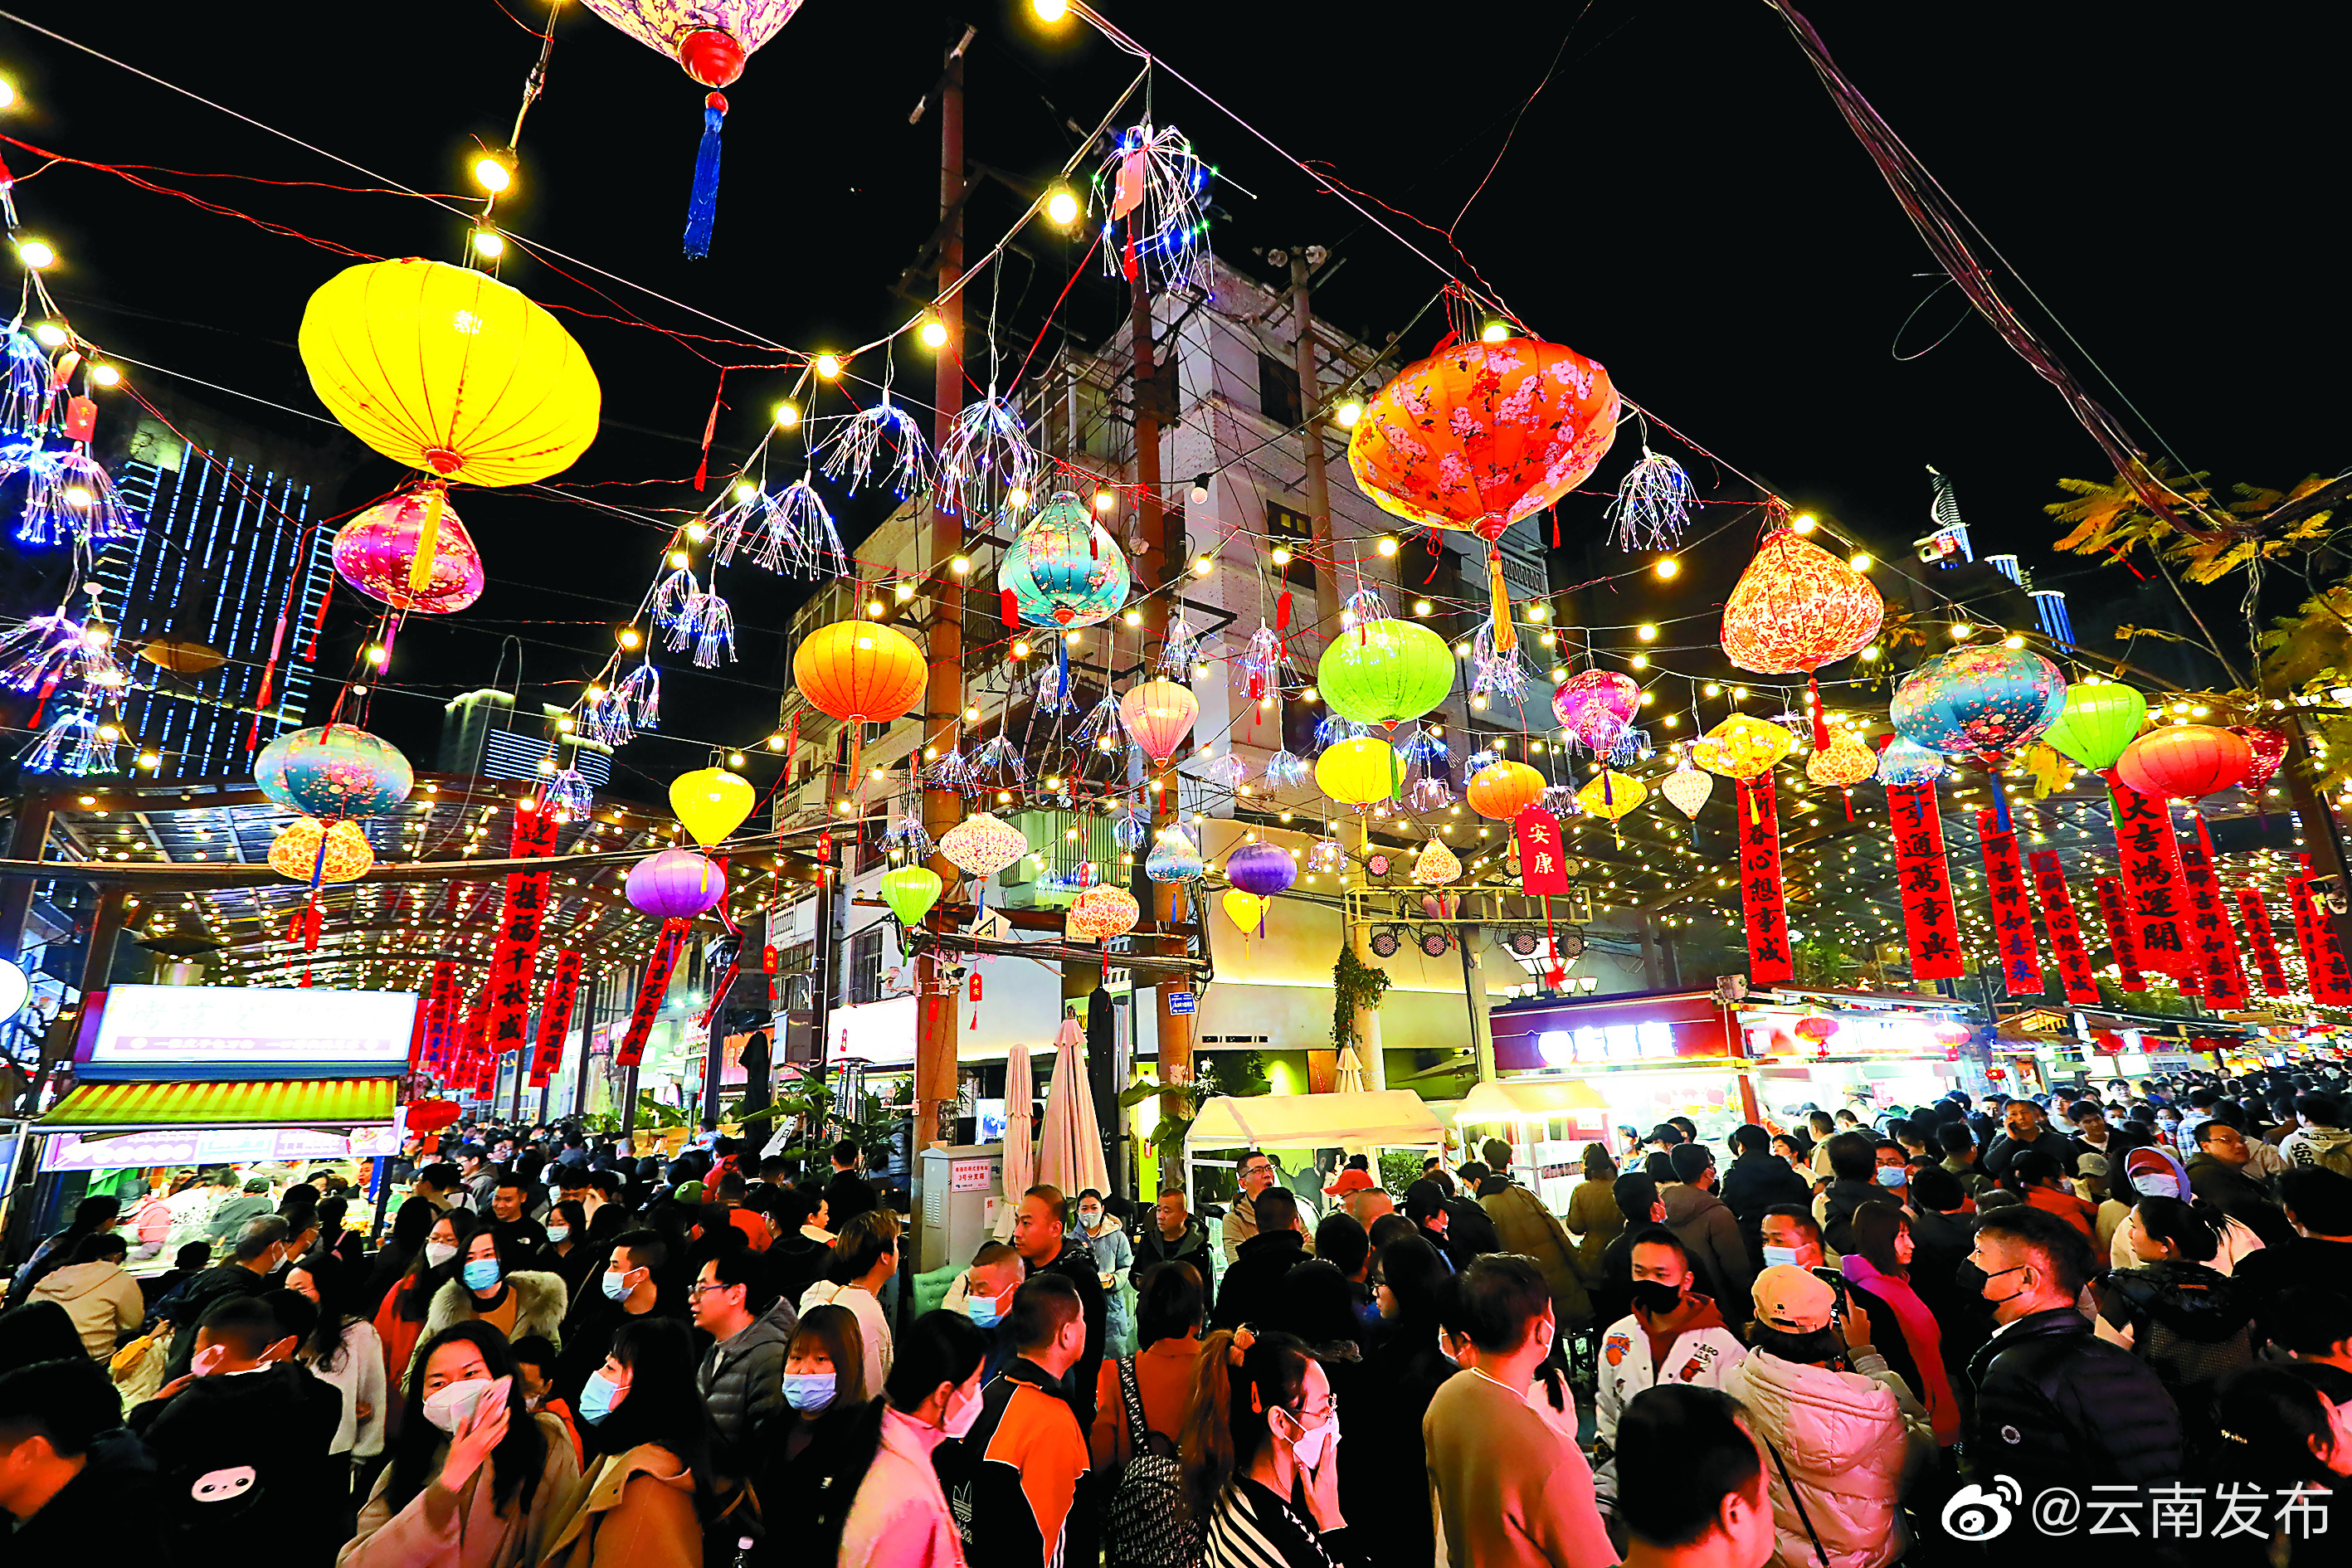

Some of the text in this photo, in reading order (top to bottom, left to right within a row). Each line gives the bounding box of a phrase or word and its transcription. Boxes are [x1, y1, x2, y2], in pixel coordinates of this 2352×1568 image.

[1527, 823, 1555, 874] 安康
[1742, 778, 1785, 963] 新春心想事成
[1894, 786, 1955, 962] 亨通萬事興
[2116, 782, 2183, 952] 大吉鴻運開
[972, 978, 980, 996] 平安
